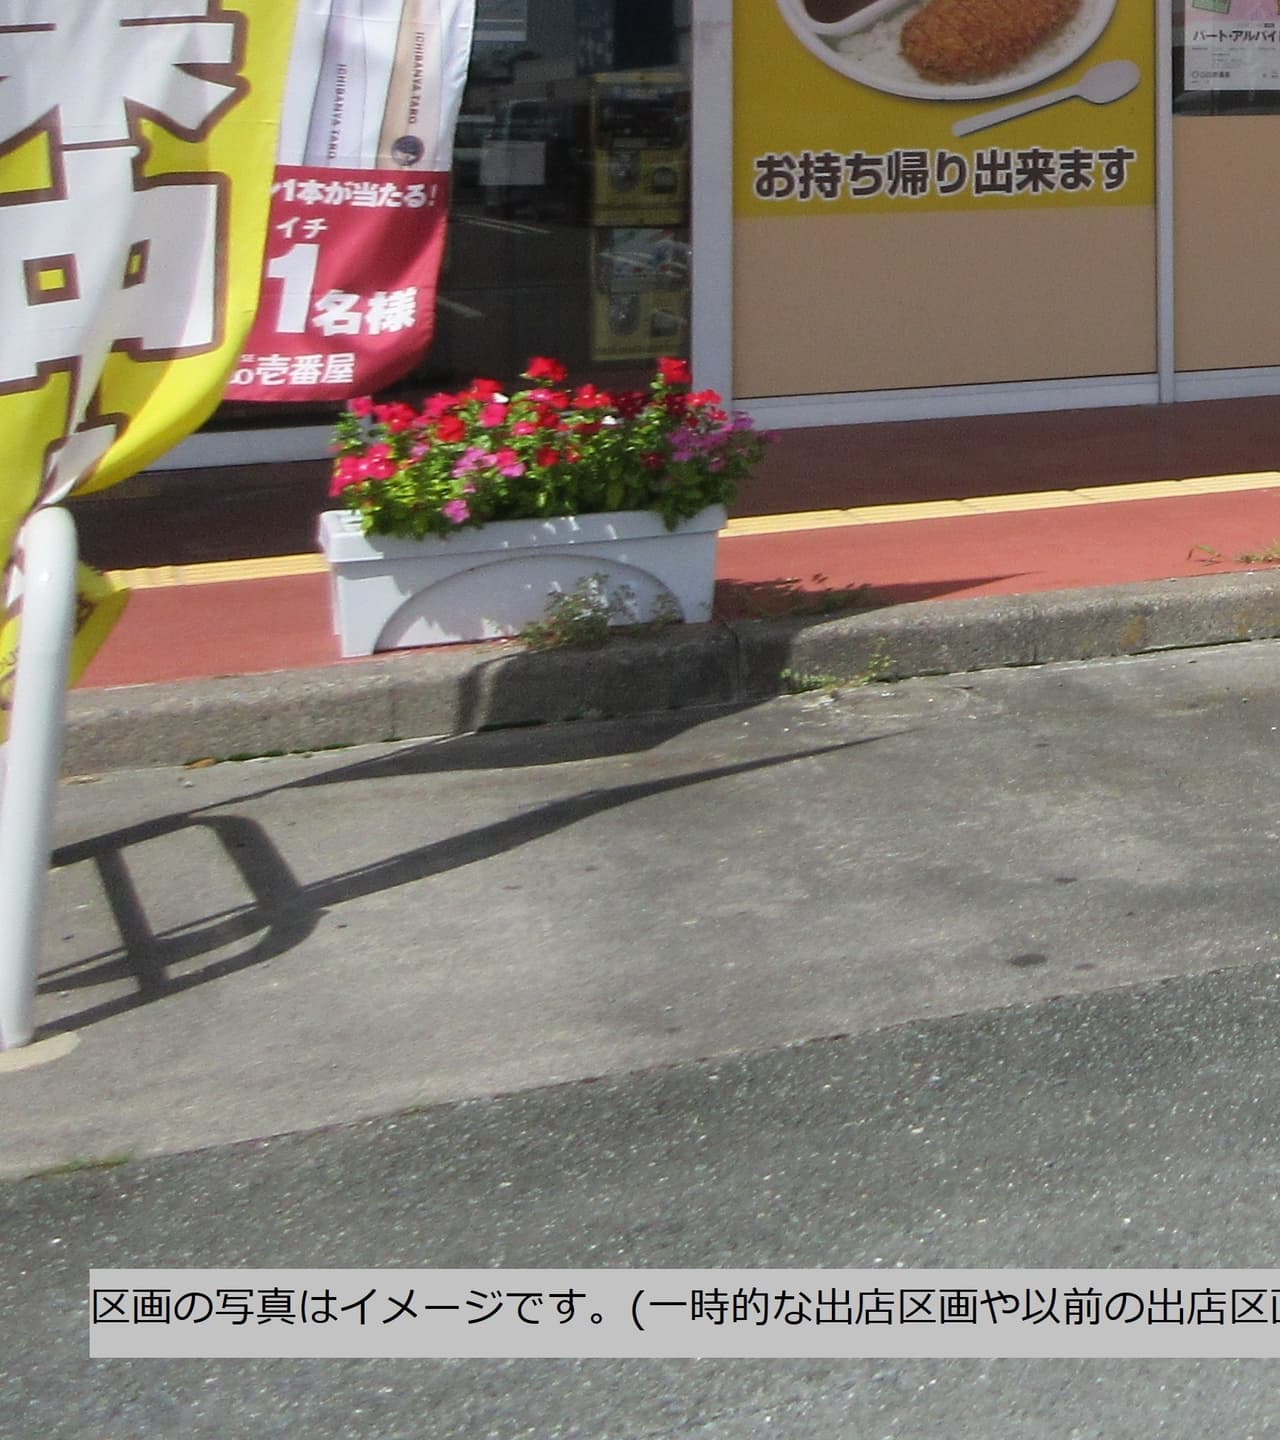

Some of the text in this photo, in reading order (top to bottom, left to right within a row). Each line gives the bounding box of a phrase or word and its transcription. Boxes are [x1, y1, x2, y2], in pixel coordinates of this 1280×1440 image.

[271, 179, 437, 209] 1本が当たる!
[754, 147, 1135, 200] お持ち帰り出来ます
[276, 216, 329, 240] イチ
[266, 243, 418, 337] 1名様
